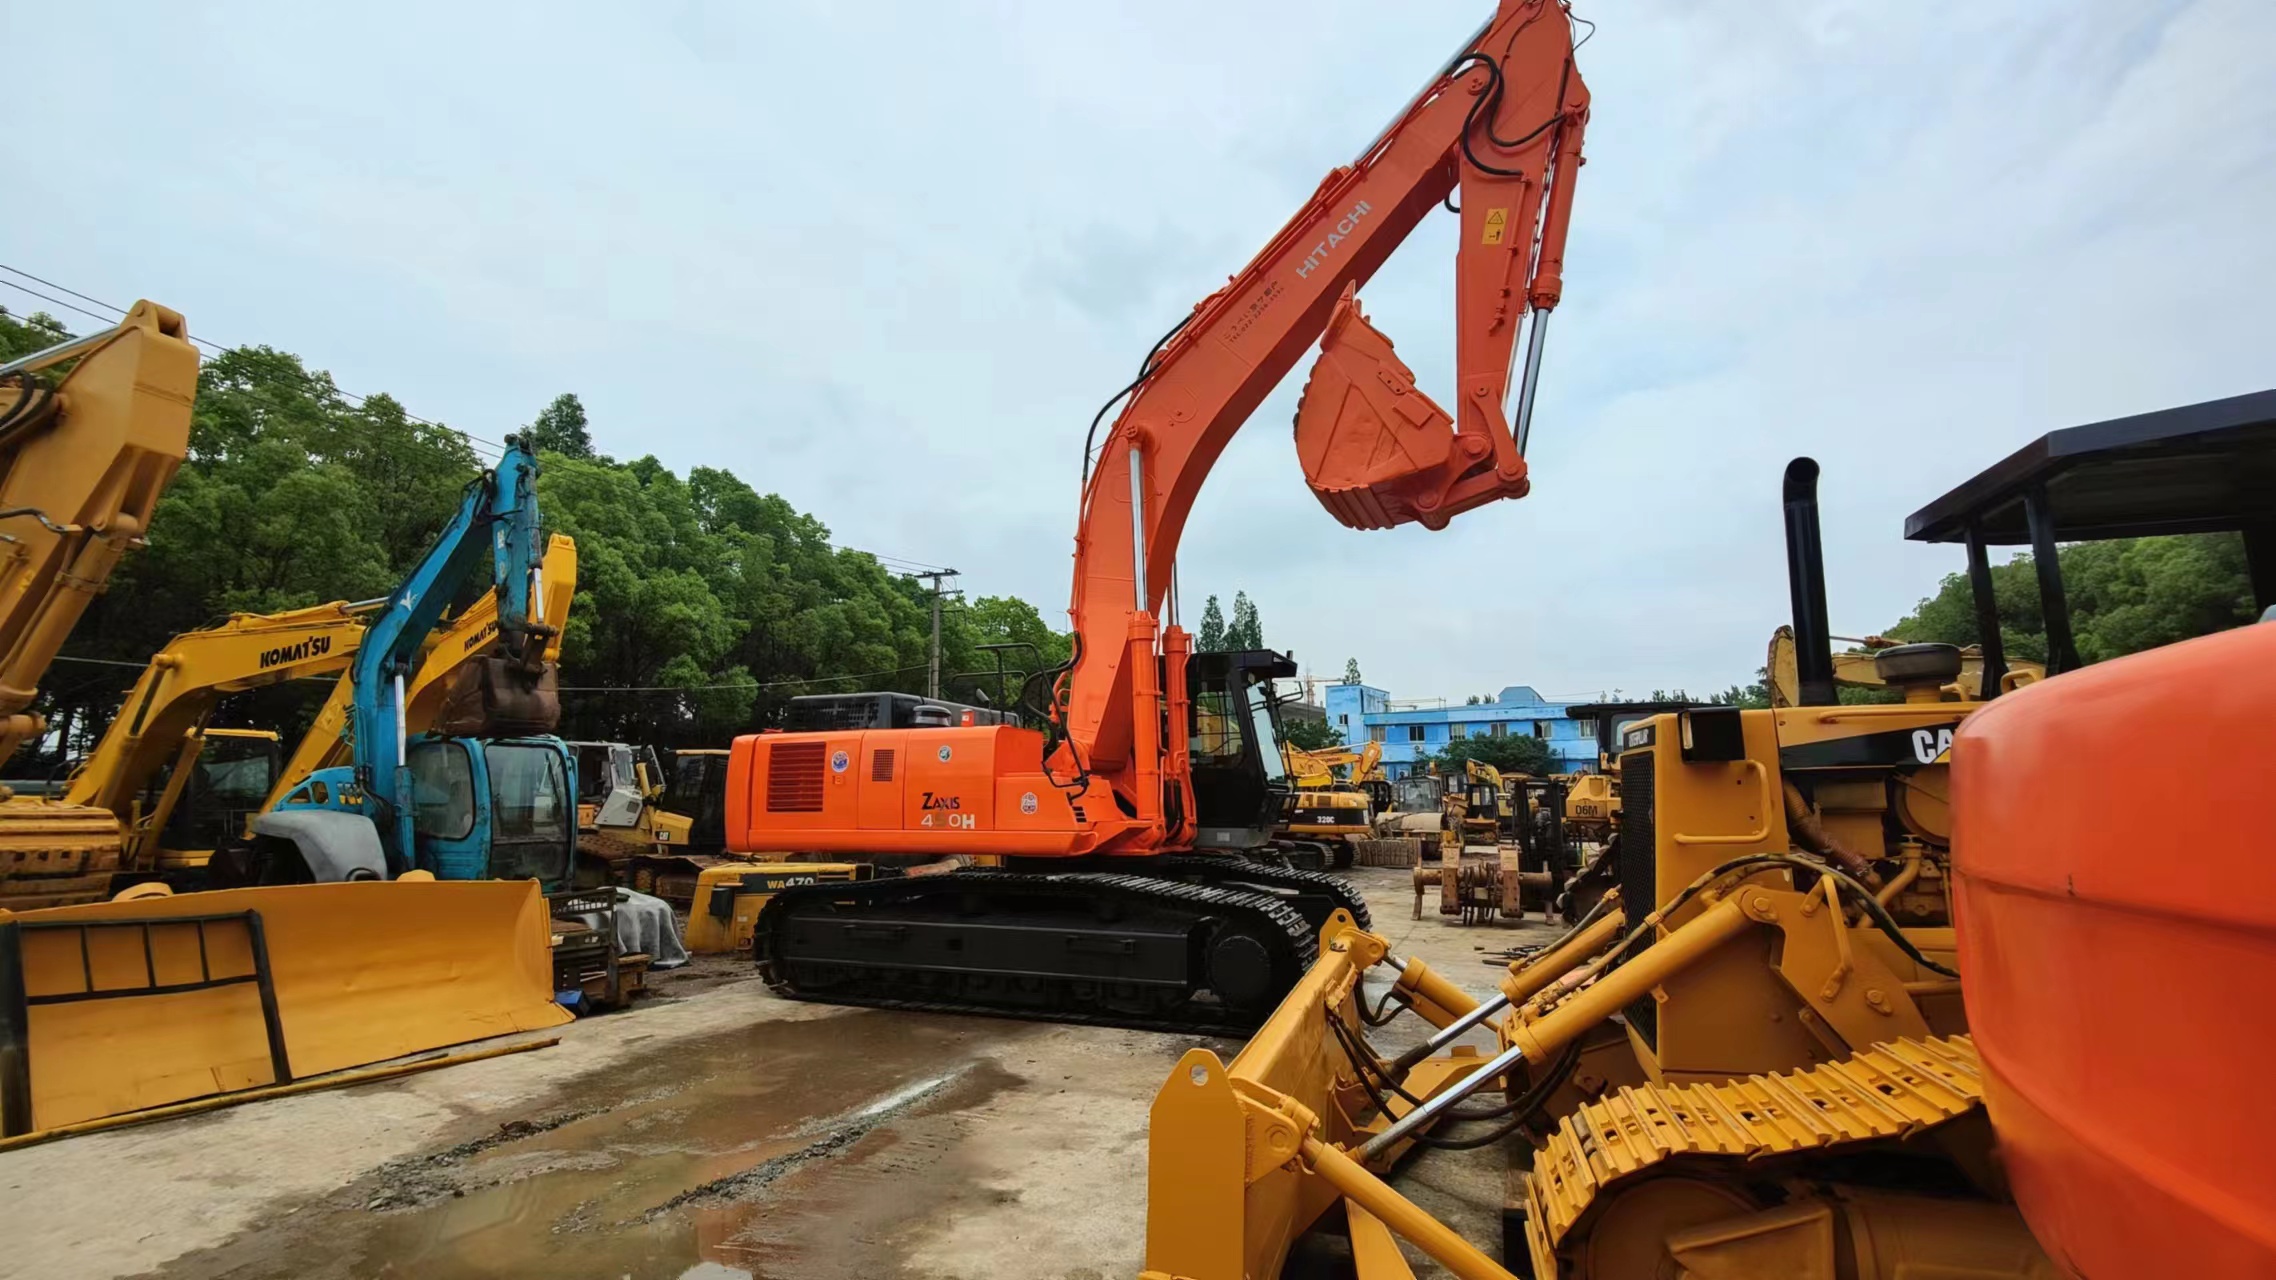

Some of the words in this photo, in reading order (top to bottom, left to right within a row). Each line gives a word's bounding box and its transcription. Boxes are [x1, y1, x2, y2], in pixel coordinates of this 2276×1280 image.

[1296, 200, 1372, 279] HITACHI
[1912, 729, 1953, 764] CA
[921, 792, 960, 810] ZAXIS
[1576, 805, 1598, 815] D6M
[1317, 816, 1335, 824] 320C
